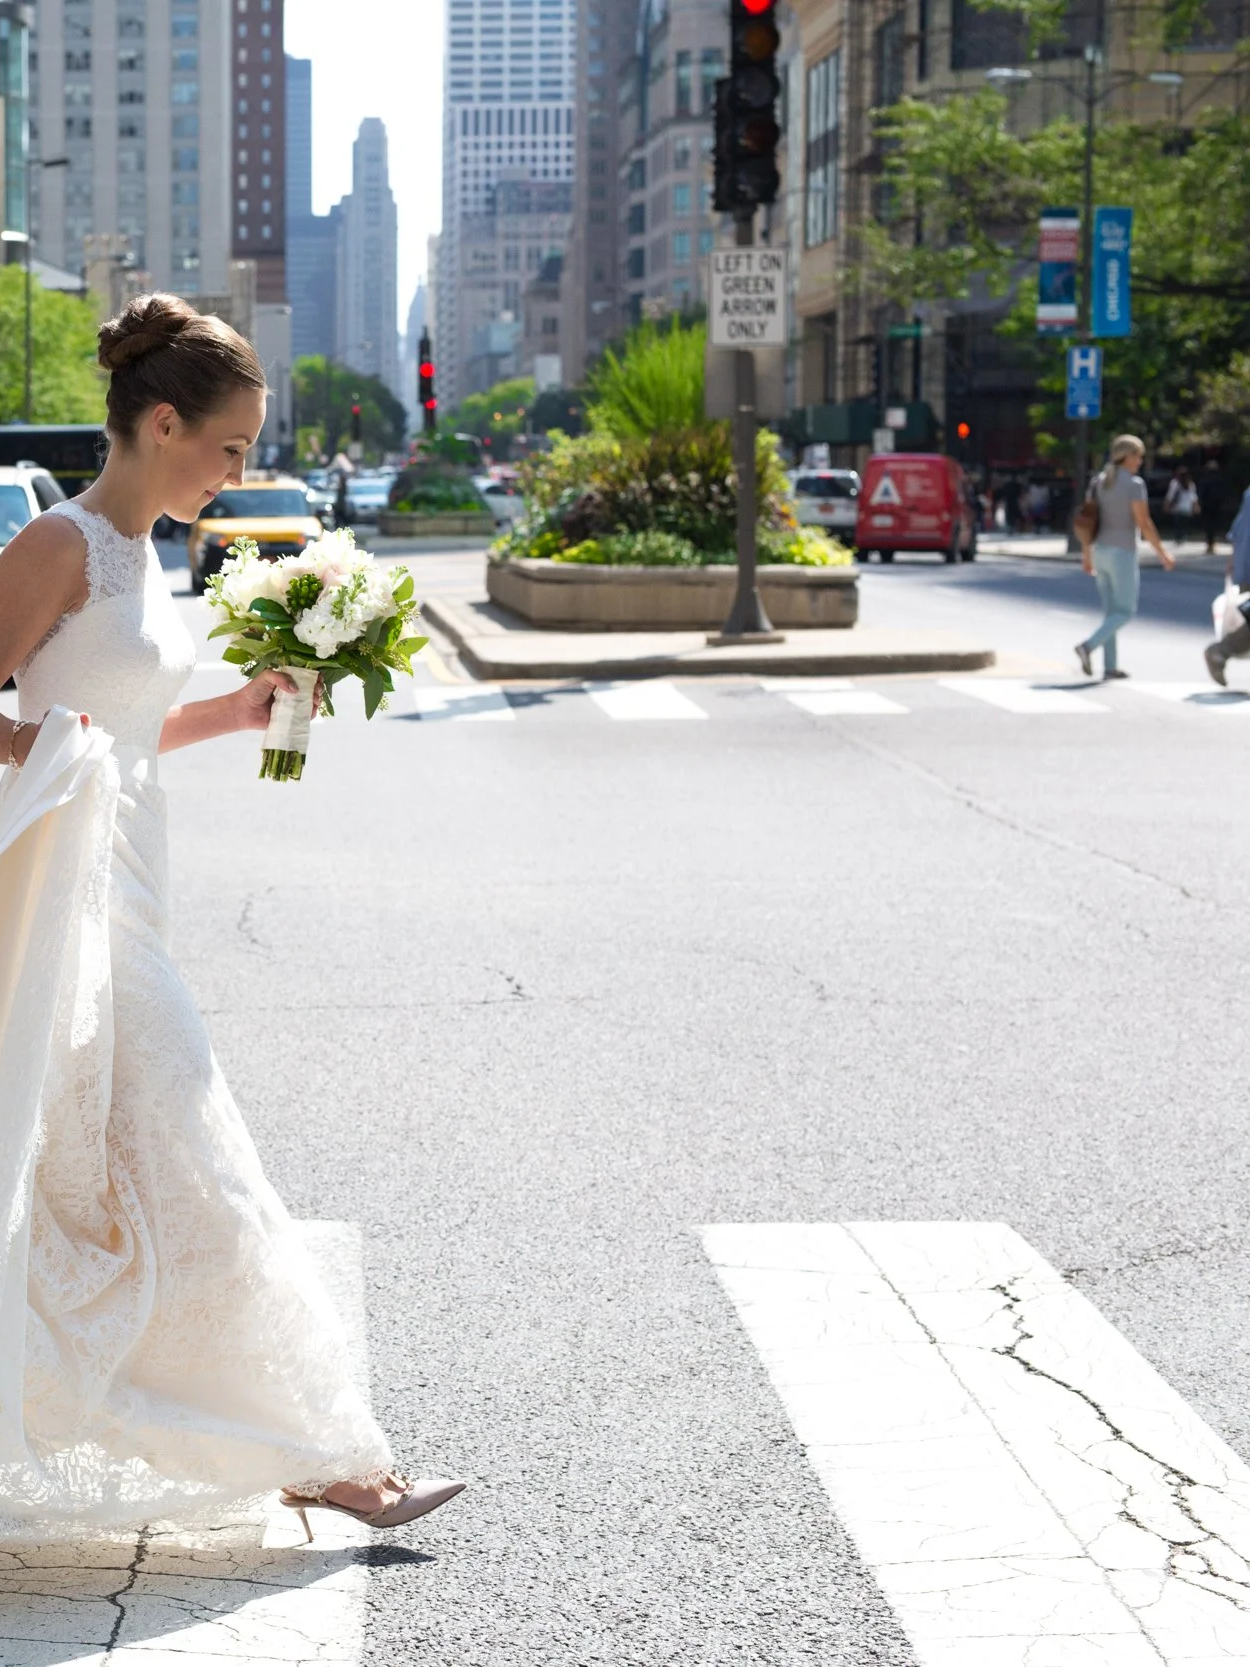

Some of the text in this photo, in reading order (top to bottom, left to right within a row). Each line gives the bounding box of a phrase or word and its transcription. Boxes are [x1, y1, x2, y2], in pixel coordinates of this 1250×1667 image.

[714, 253, 782, 274] LEFT ON
[722, 275, 775, 295] GREEN
[719, 298, 777, 318] ARROW
[727, 320, 769, 339] ONLY
[1072, 347, 1097, 378] H
